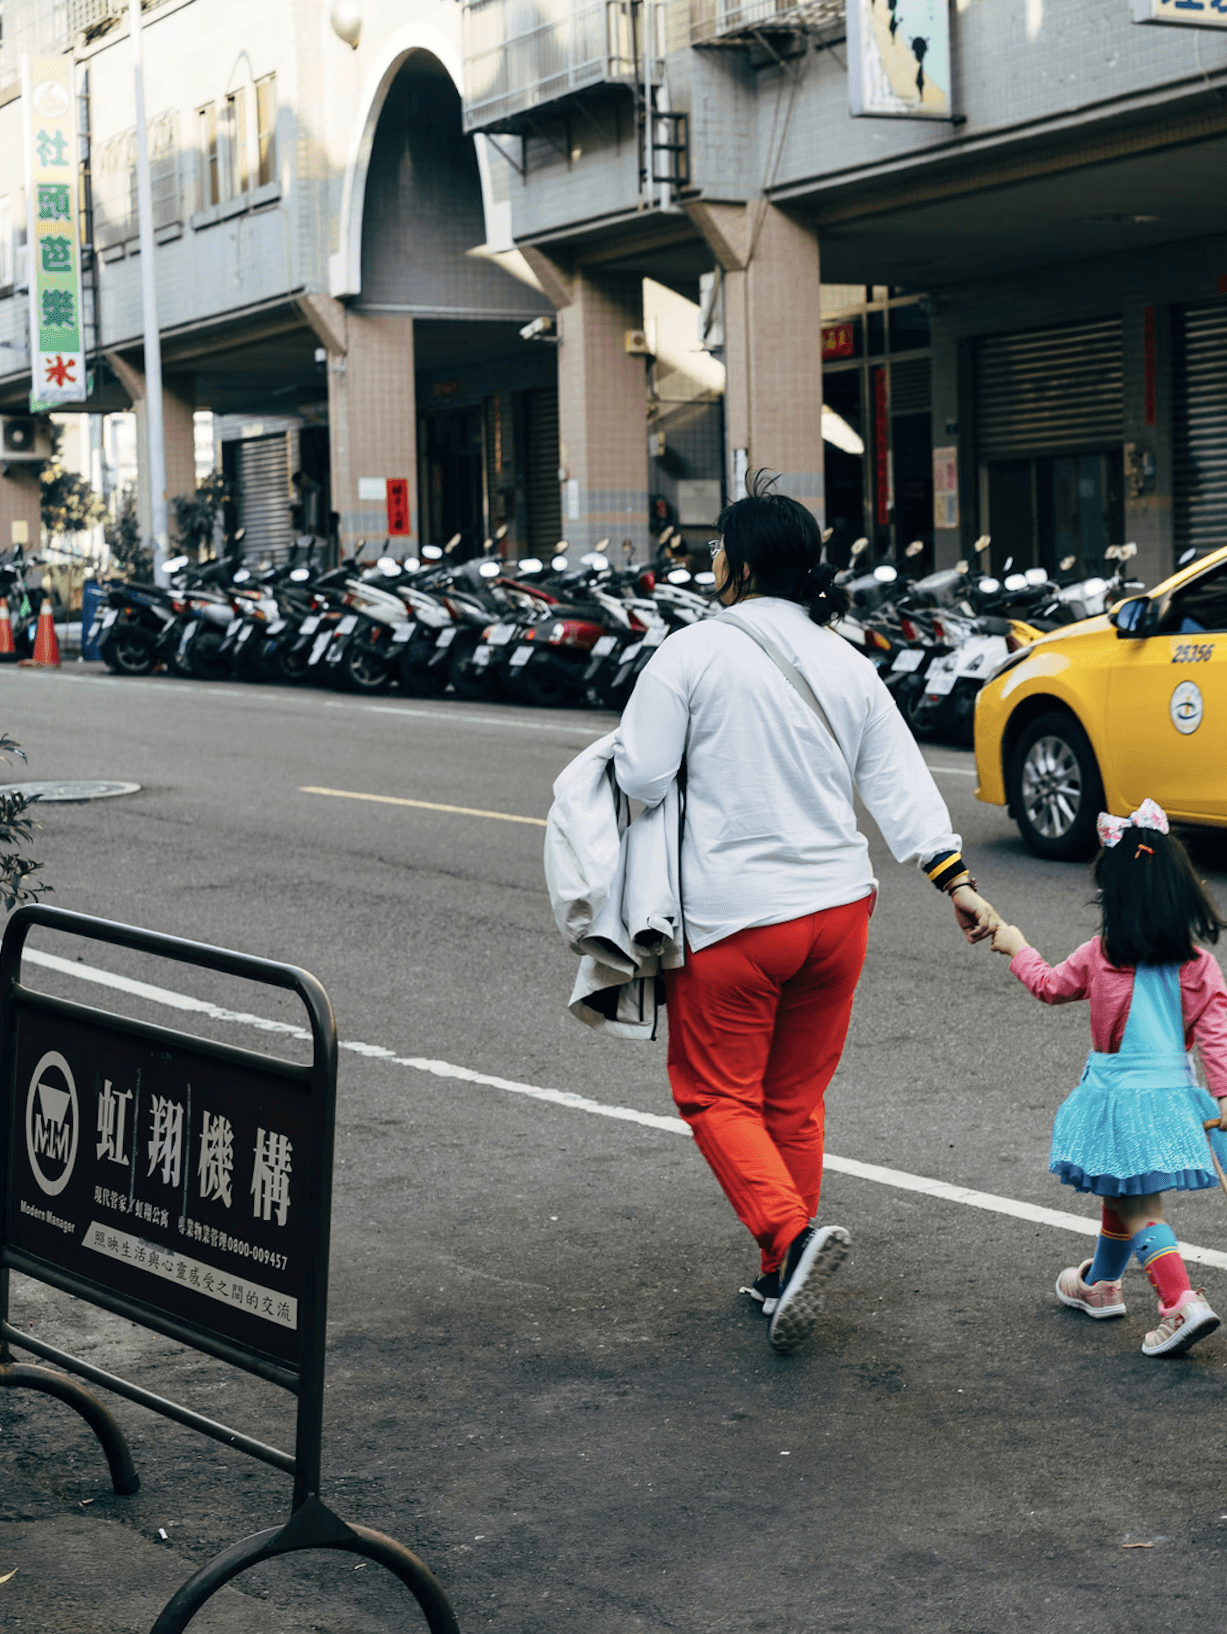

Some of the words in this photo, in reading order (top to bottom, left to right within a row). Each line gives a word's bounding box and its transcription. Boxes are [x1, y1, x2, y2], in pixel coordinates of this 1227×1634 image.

[1171, 644, 1216, 664] 25356
[96, 1079, 293, 1227] 虹翔機構
[20, 1200, 45, 1222] Modern
[46, 1210, 75, 1233] Manager
